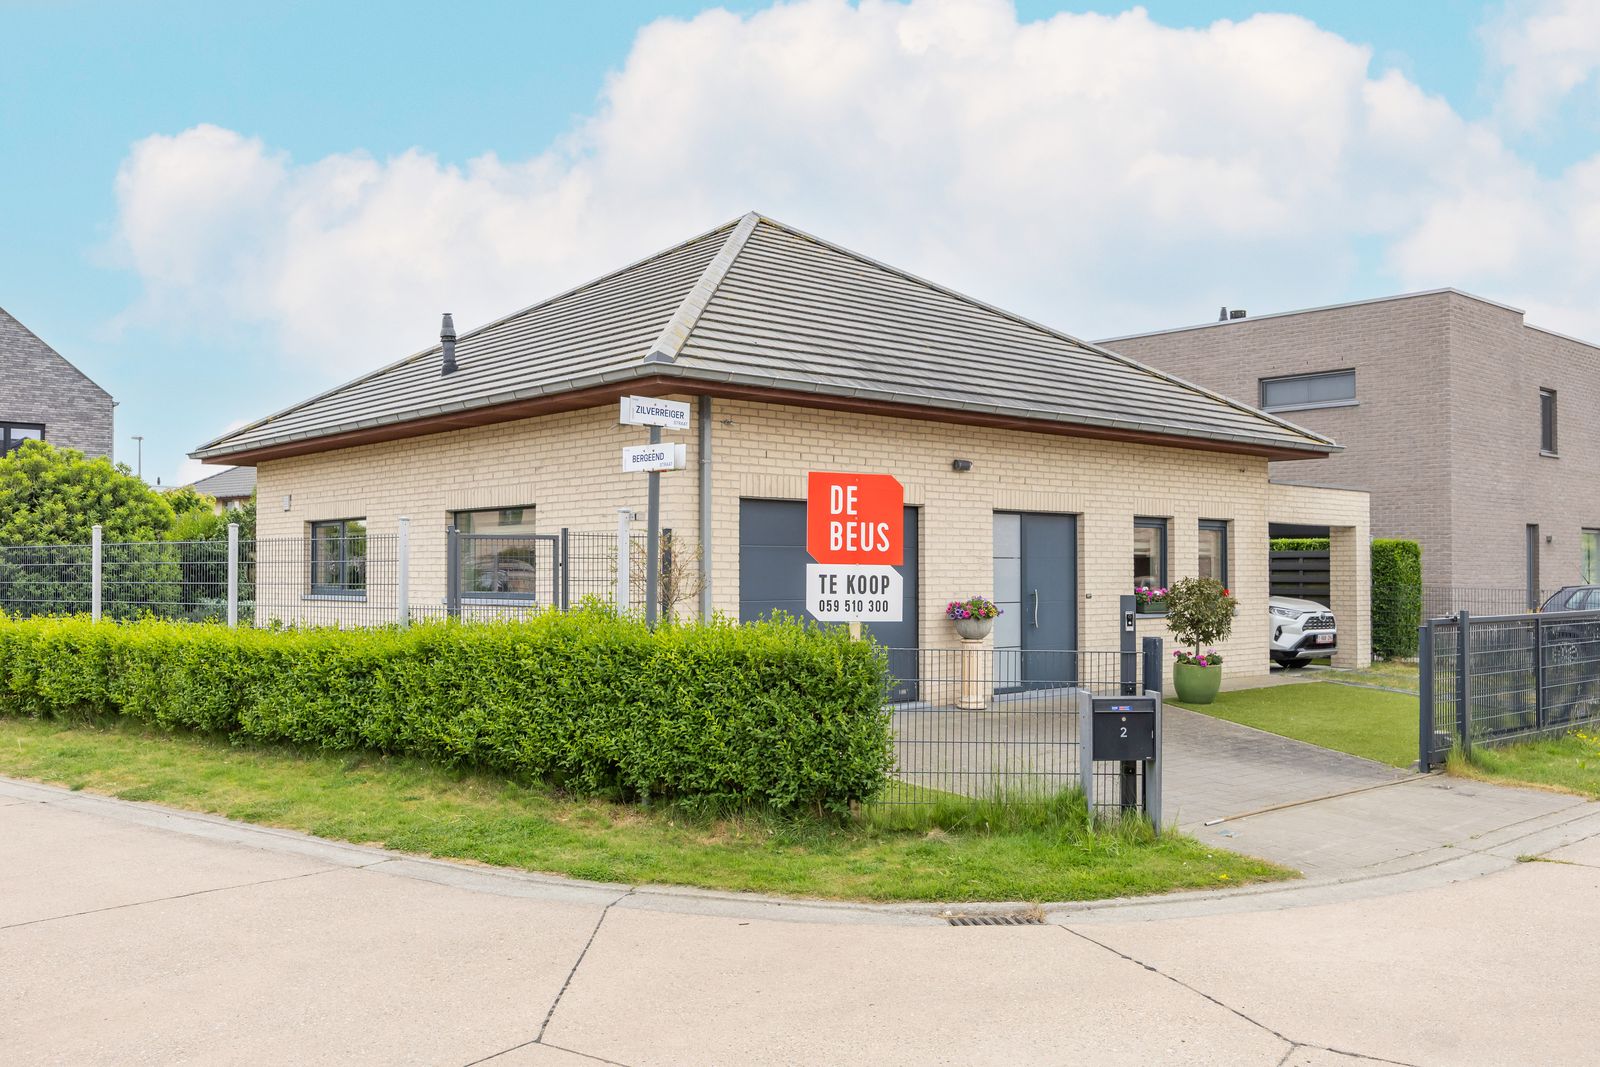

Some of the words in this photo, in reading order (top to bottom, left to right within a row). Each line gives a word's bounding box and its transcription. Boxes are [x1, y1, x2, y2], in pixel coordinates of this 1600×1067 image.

[635, 405, 685, 419] ZILVERREIGER
[632, 452, 665, 463] BERGEEND
[830, 485, 858, 515] DE
[830, 521, 890, 552] BEUS
[818, 574, 837, 594] TE
[846, 574, 890, 595] KOOP
[819, 600, 840, 613] 059
[844, 600, 863, 613] 510
[868, 600, 889, 613] 300
[1120, 727, 1127, 737] 2
